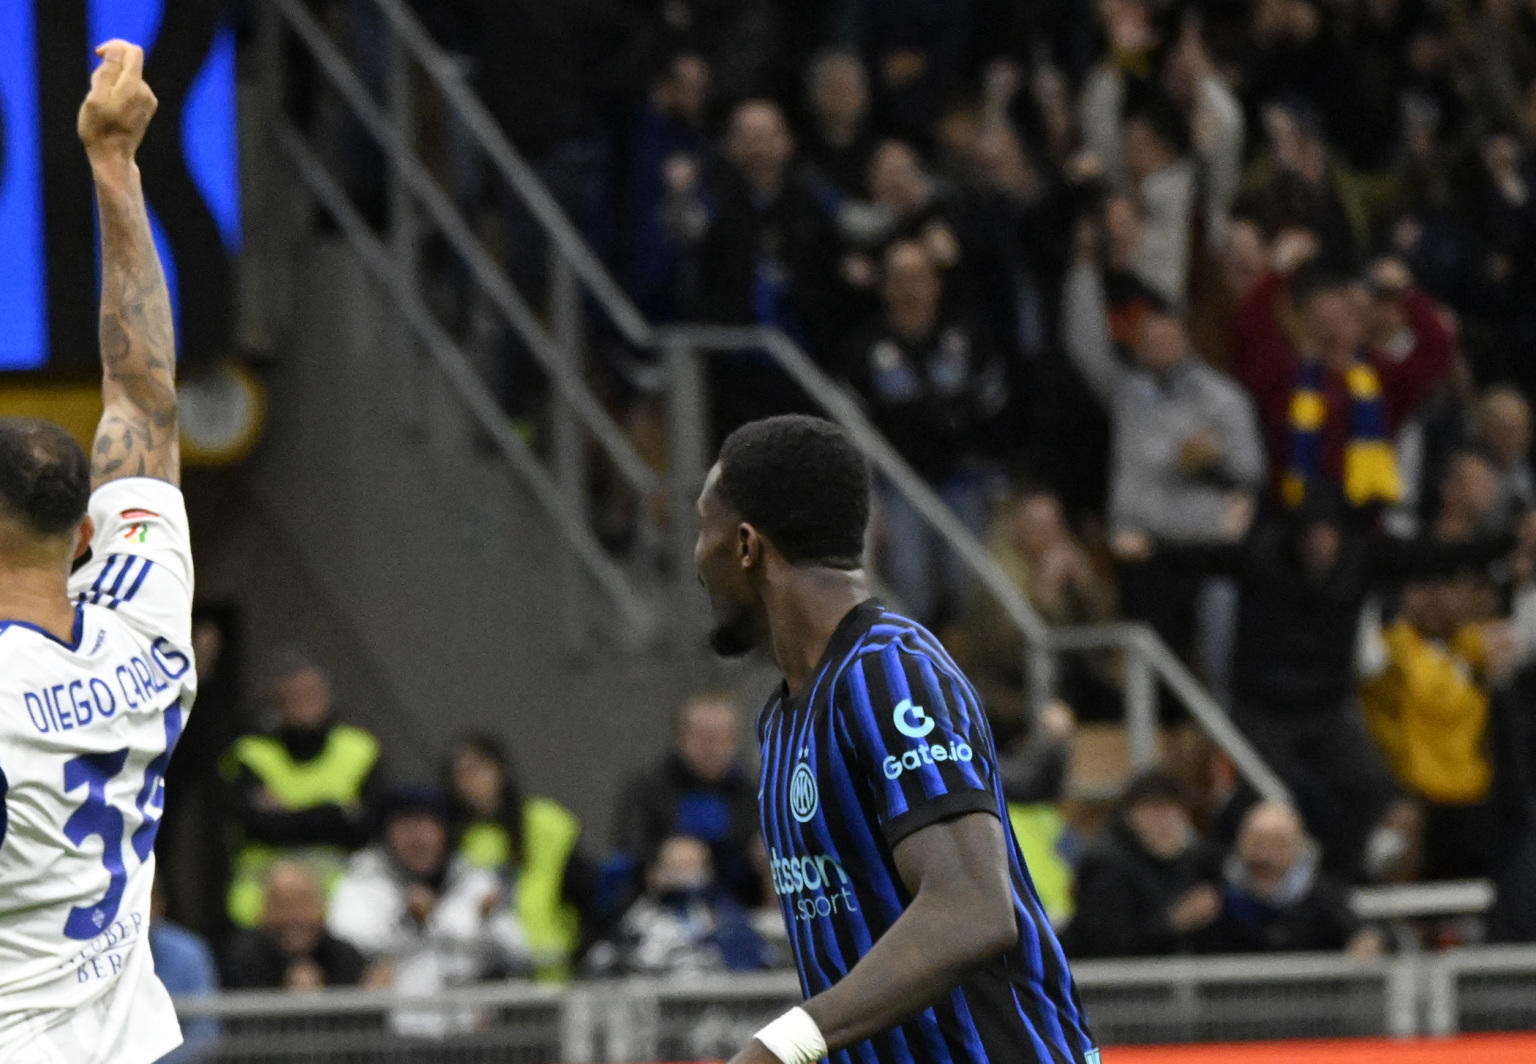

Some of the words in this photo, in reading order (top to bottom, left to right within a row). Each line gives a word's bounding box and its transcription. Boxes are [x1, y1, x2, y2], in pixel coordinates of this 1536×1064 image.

[23, 677, 116, 733] DIEGO
[882, 740, 973, 780] Gate.io
[63, 698, 183, 940] 34
[769, 846, 849, 895] tsson
